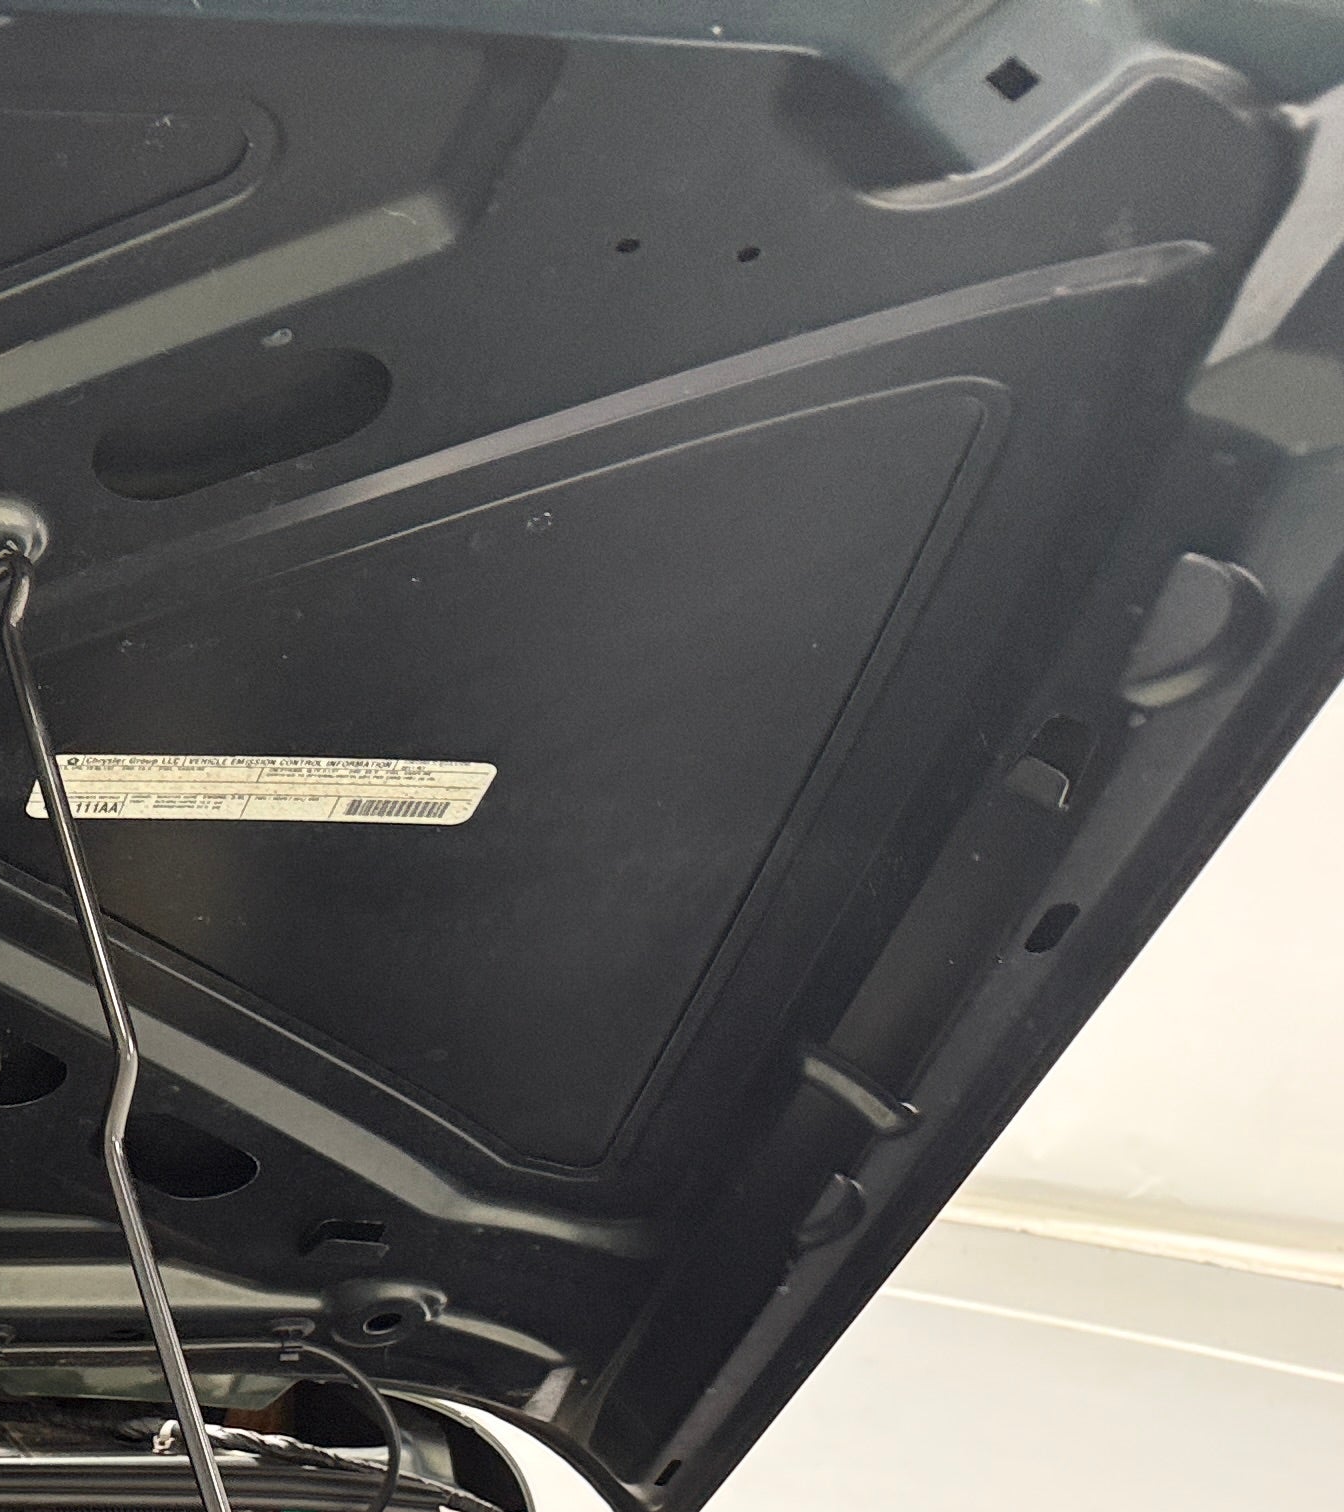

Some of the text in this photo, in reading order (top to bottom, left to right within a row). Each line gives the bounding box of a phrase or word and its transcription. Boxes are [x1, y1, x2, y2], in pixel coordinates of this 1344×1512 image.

[86, 757, 181, 767] Chrysler Group LLC
[189, 757, 228, 766] VEHICLE
[231, 758, 276, 767] EMISSION
[280, 759, 321, 767] CONTROL
[326, 760, 392, 769] INFORMATION
